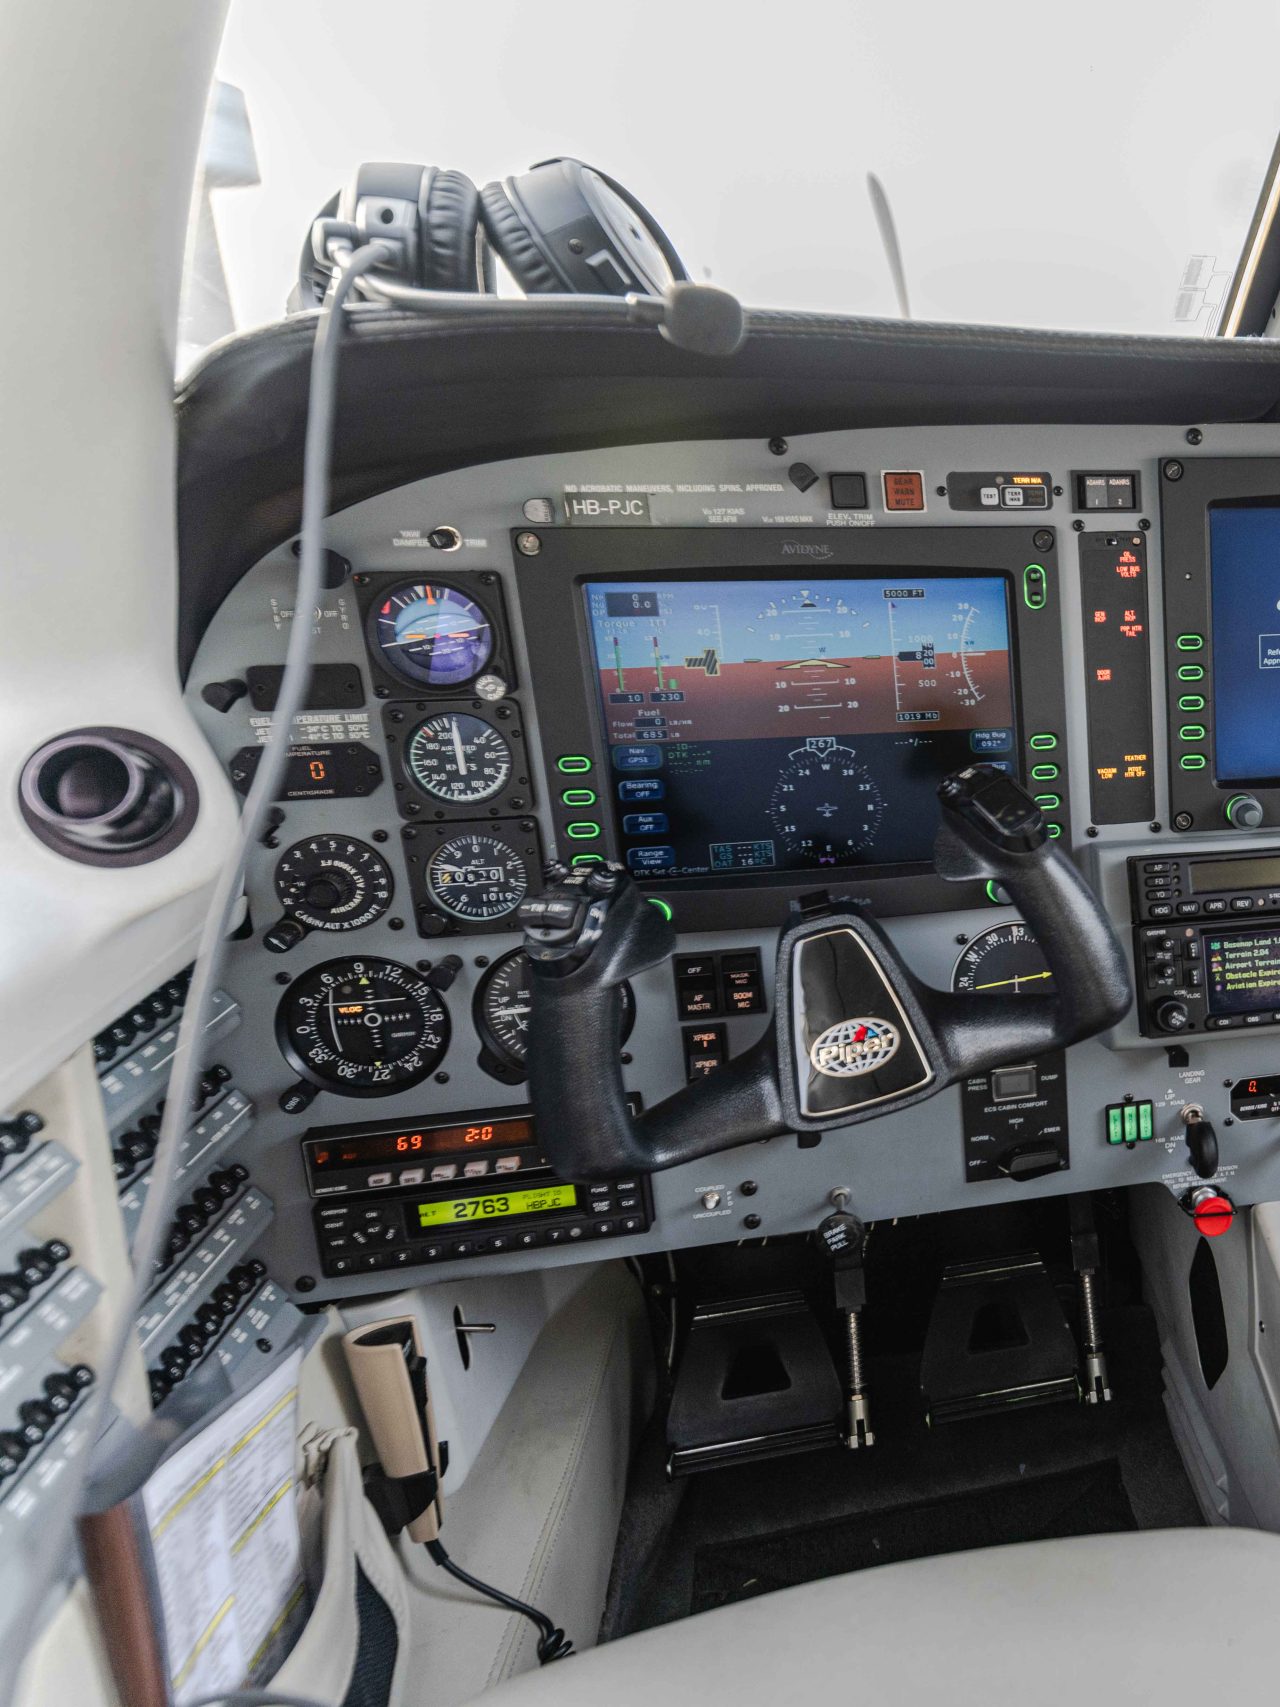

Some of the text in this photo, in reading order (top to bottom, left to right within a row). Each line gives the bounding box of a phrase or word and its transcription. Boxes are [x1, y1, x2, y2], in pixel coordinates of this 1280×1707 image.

[573, 501, 643, 515] HB-PJC
[345, 714, 369, 722] LIMIT
[811, 740, 832, 748] 267
[309, 761, 326, 780] 0
[626, 782, 658, 790] Bearing
[483, 893, 513, 902] 1019
[354, 962, 365, 973] 9
[385, 965, 402, 978] 12
[320, 973, 334, 984] 6
[1226, 972, 1257, 980] Obstacle
[413, 981, 431, 996] 15
[1226, 982, 1256, 990] Aviation
[299, 997, 313, 1006] 3
[430, 1007, 444, 1021] 18
[296, 1026, 310, 1034] 0
[426, 1034, 442, 1049] 21
[820, 1033, 893, 1066] Piper
[309, 1049, 328, 1064] 33
[404, 1056, 423, 1072] 24
[338, 1065, 357, 1078] 30
[372, 1069, 391, 1081] 27
[1179, 1070, 1205, 1078] LANDING
[464, 1126, 494, 1143] 2:0
[396, 1135, 423, 1151] 69
[1162, 1171, 1192, 1179] EMERGENCY
[452, 1197, 510, 1219] 2763
[526, 1198, 561, 1210] HBPJC
[823, 1223, 847, 1238] BRAKE
